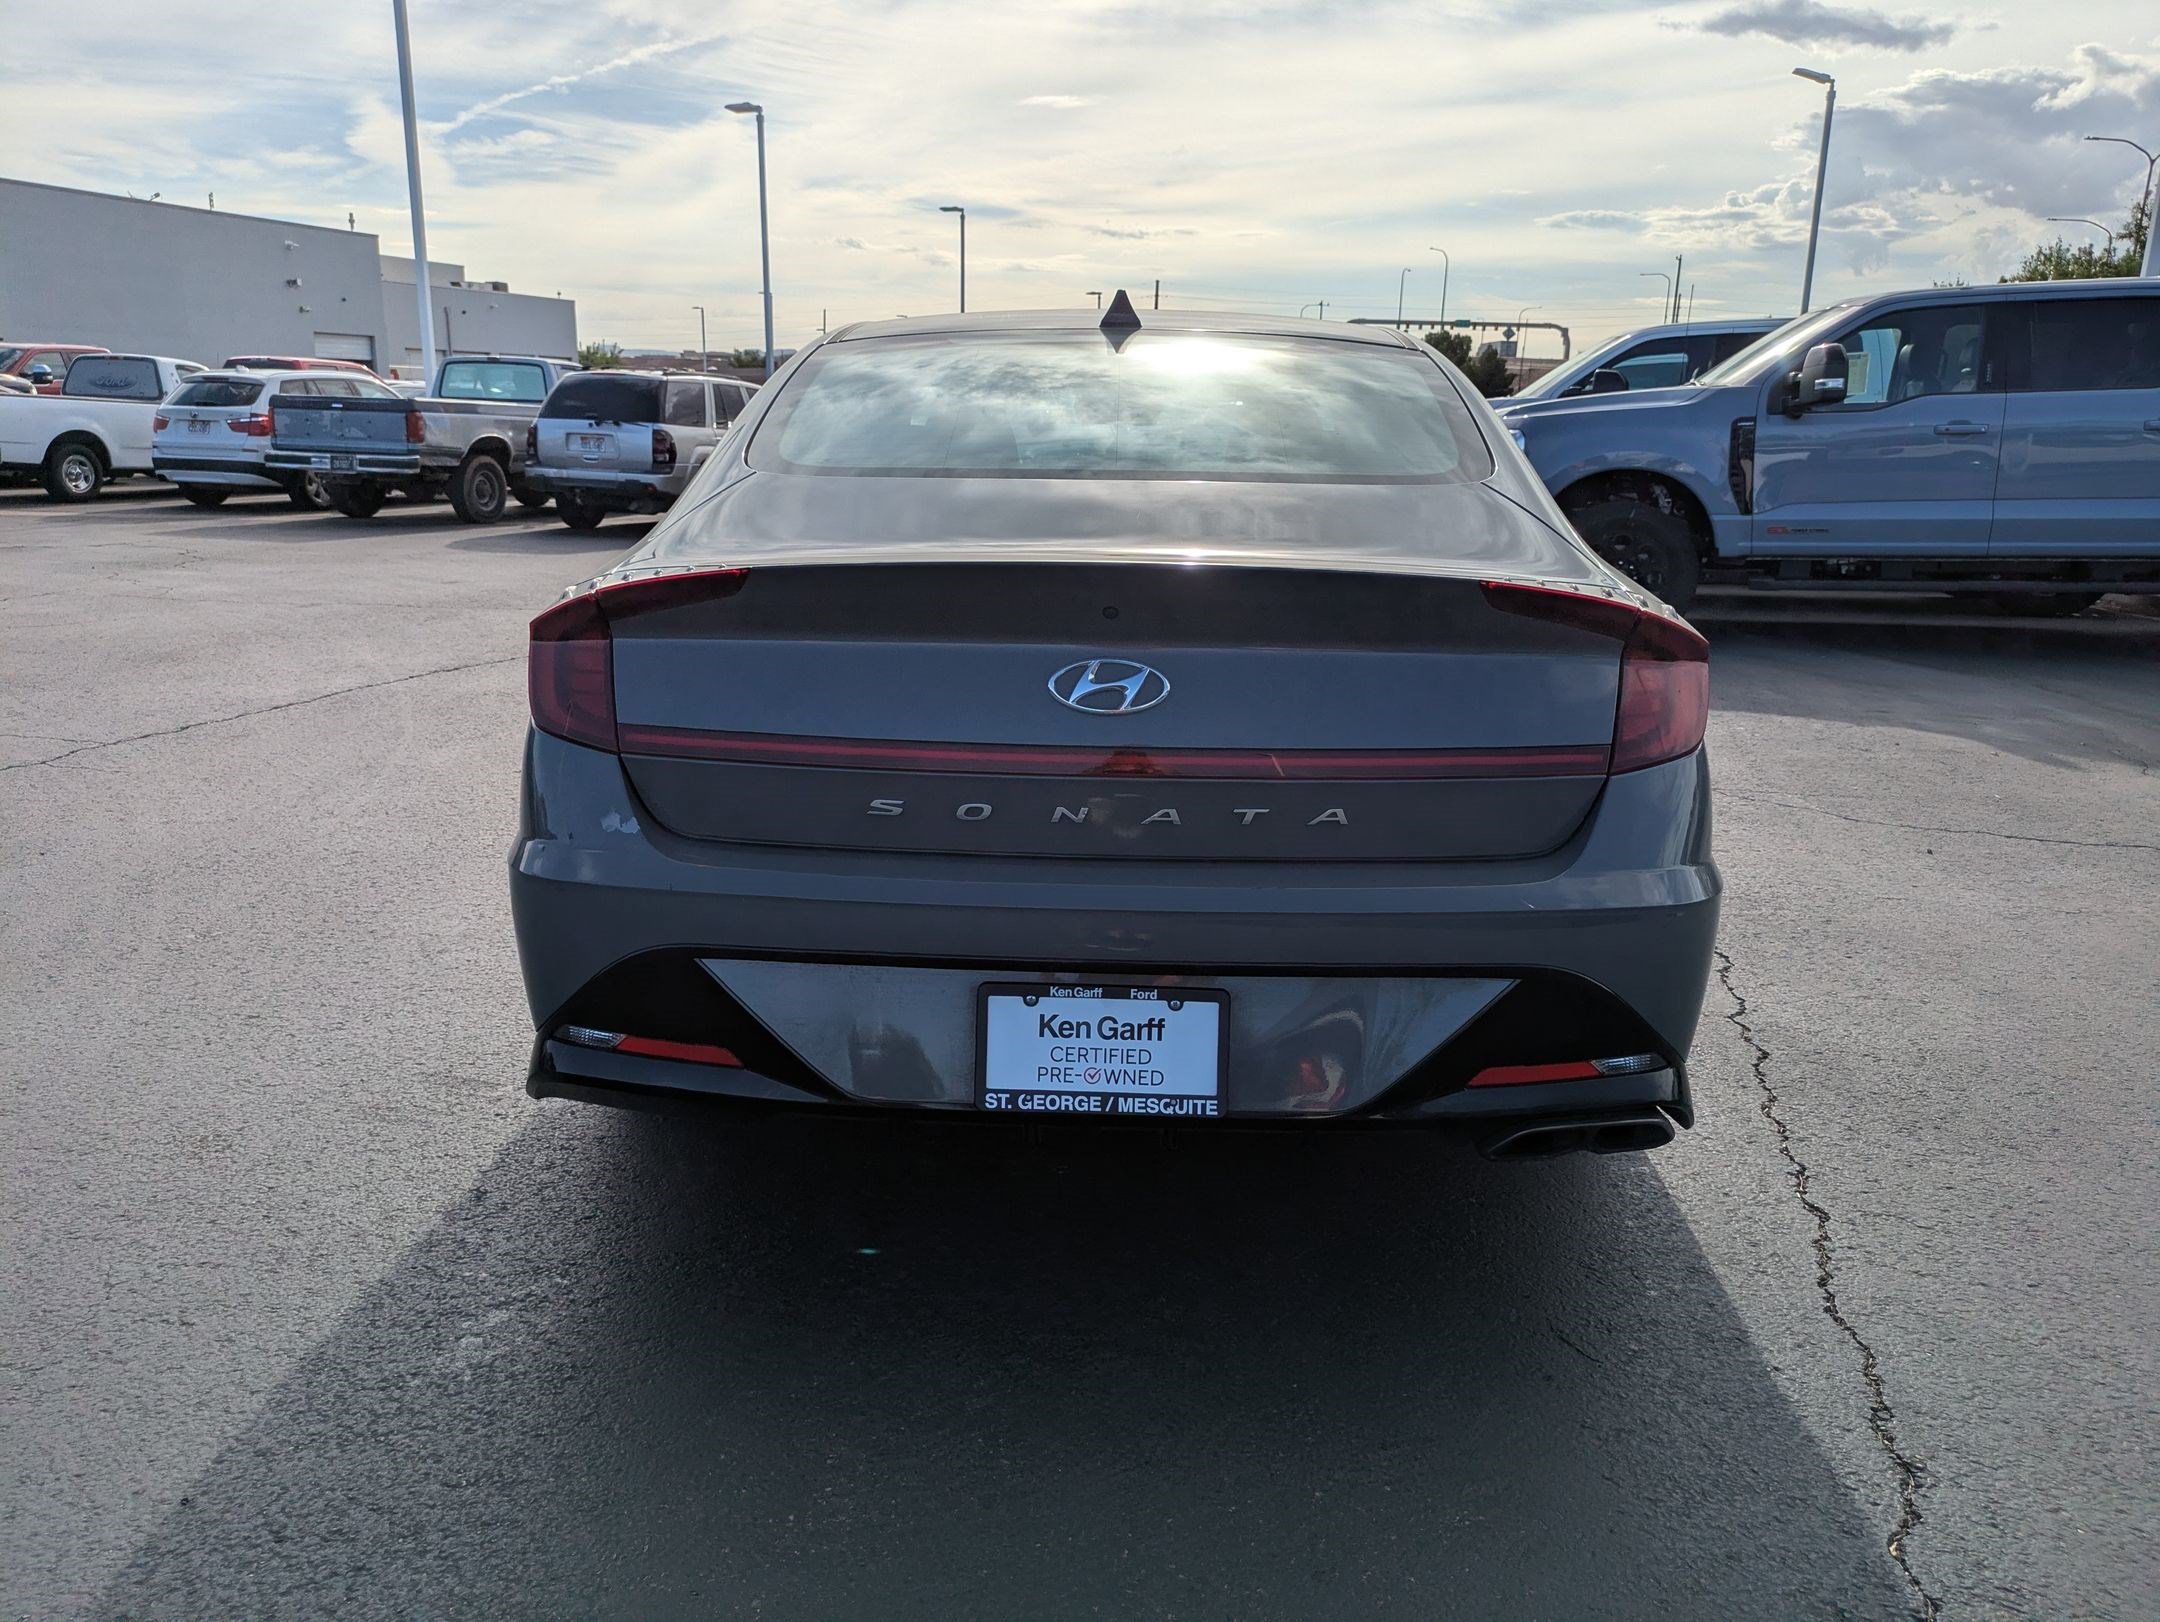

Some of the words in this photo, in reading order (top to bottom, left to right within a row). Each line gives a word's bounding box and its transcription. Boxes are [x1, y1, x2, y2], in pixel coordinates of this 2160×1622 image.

[866, 799, 1348, 825] SONATA
[1050, 986, 1072, 997] Ken
[1074, 987, 1102, 998] Garff
[1130, 989, 1157, 999] Ford
[1039, 1014, 1090, 1038] Ken
[1098, 1016, 1165, 1041] Garff
[1050, 1046, 1152, 1065] CERTIFIED
[1038, 1066, 1164, 1086] PRE-OWNED
[985, 1093, 1011, 1109] ST.
[1018, 1094, 1101, 1112] GEORGE
[1105, 1097, 1113, 1112] /
[1118, 1097, 1218, 1115] MESQUITE
